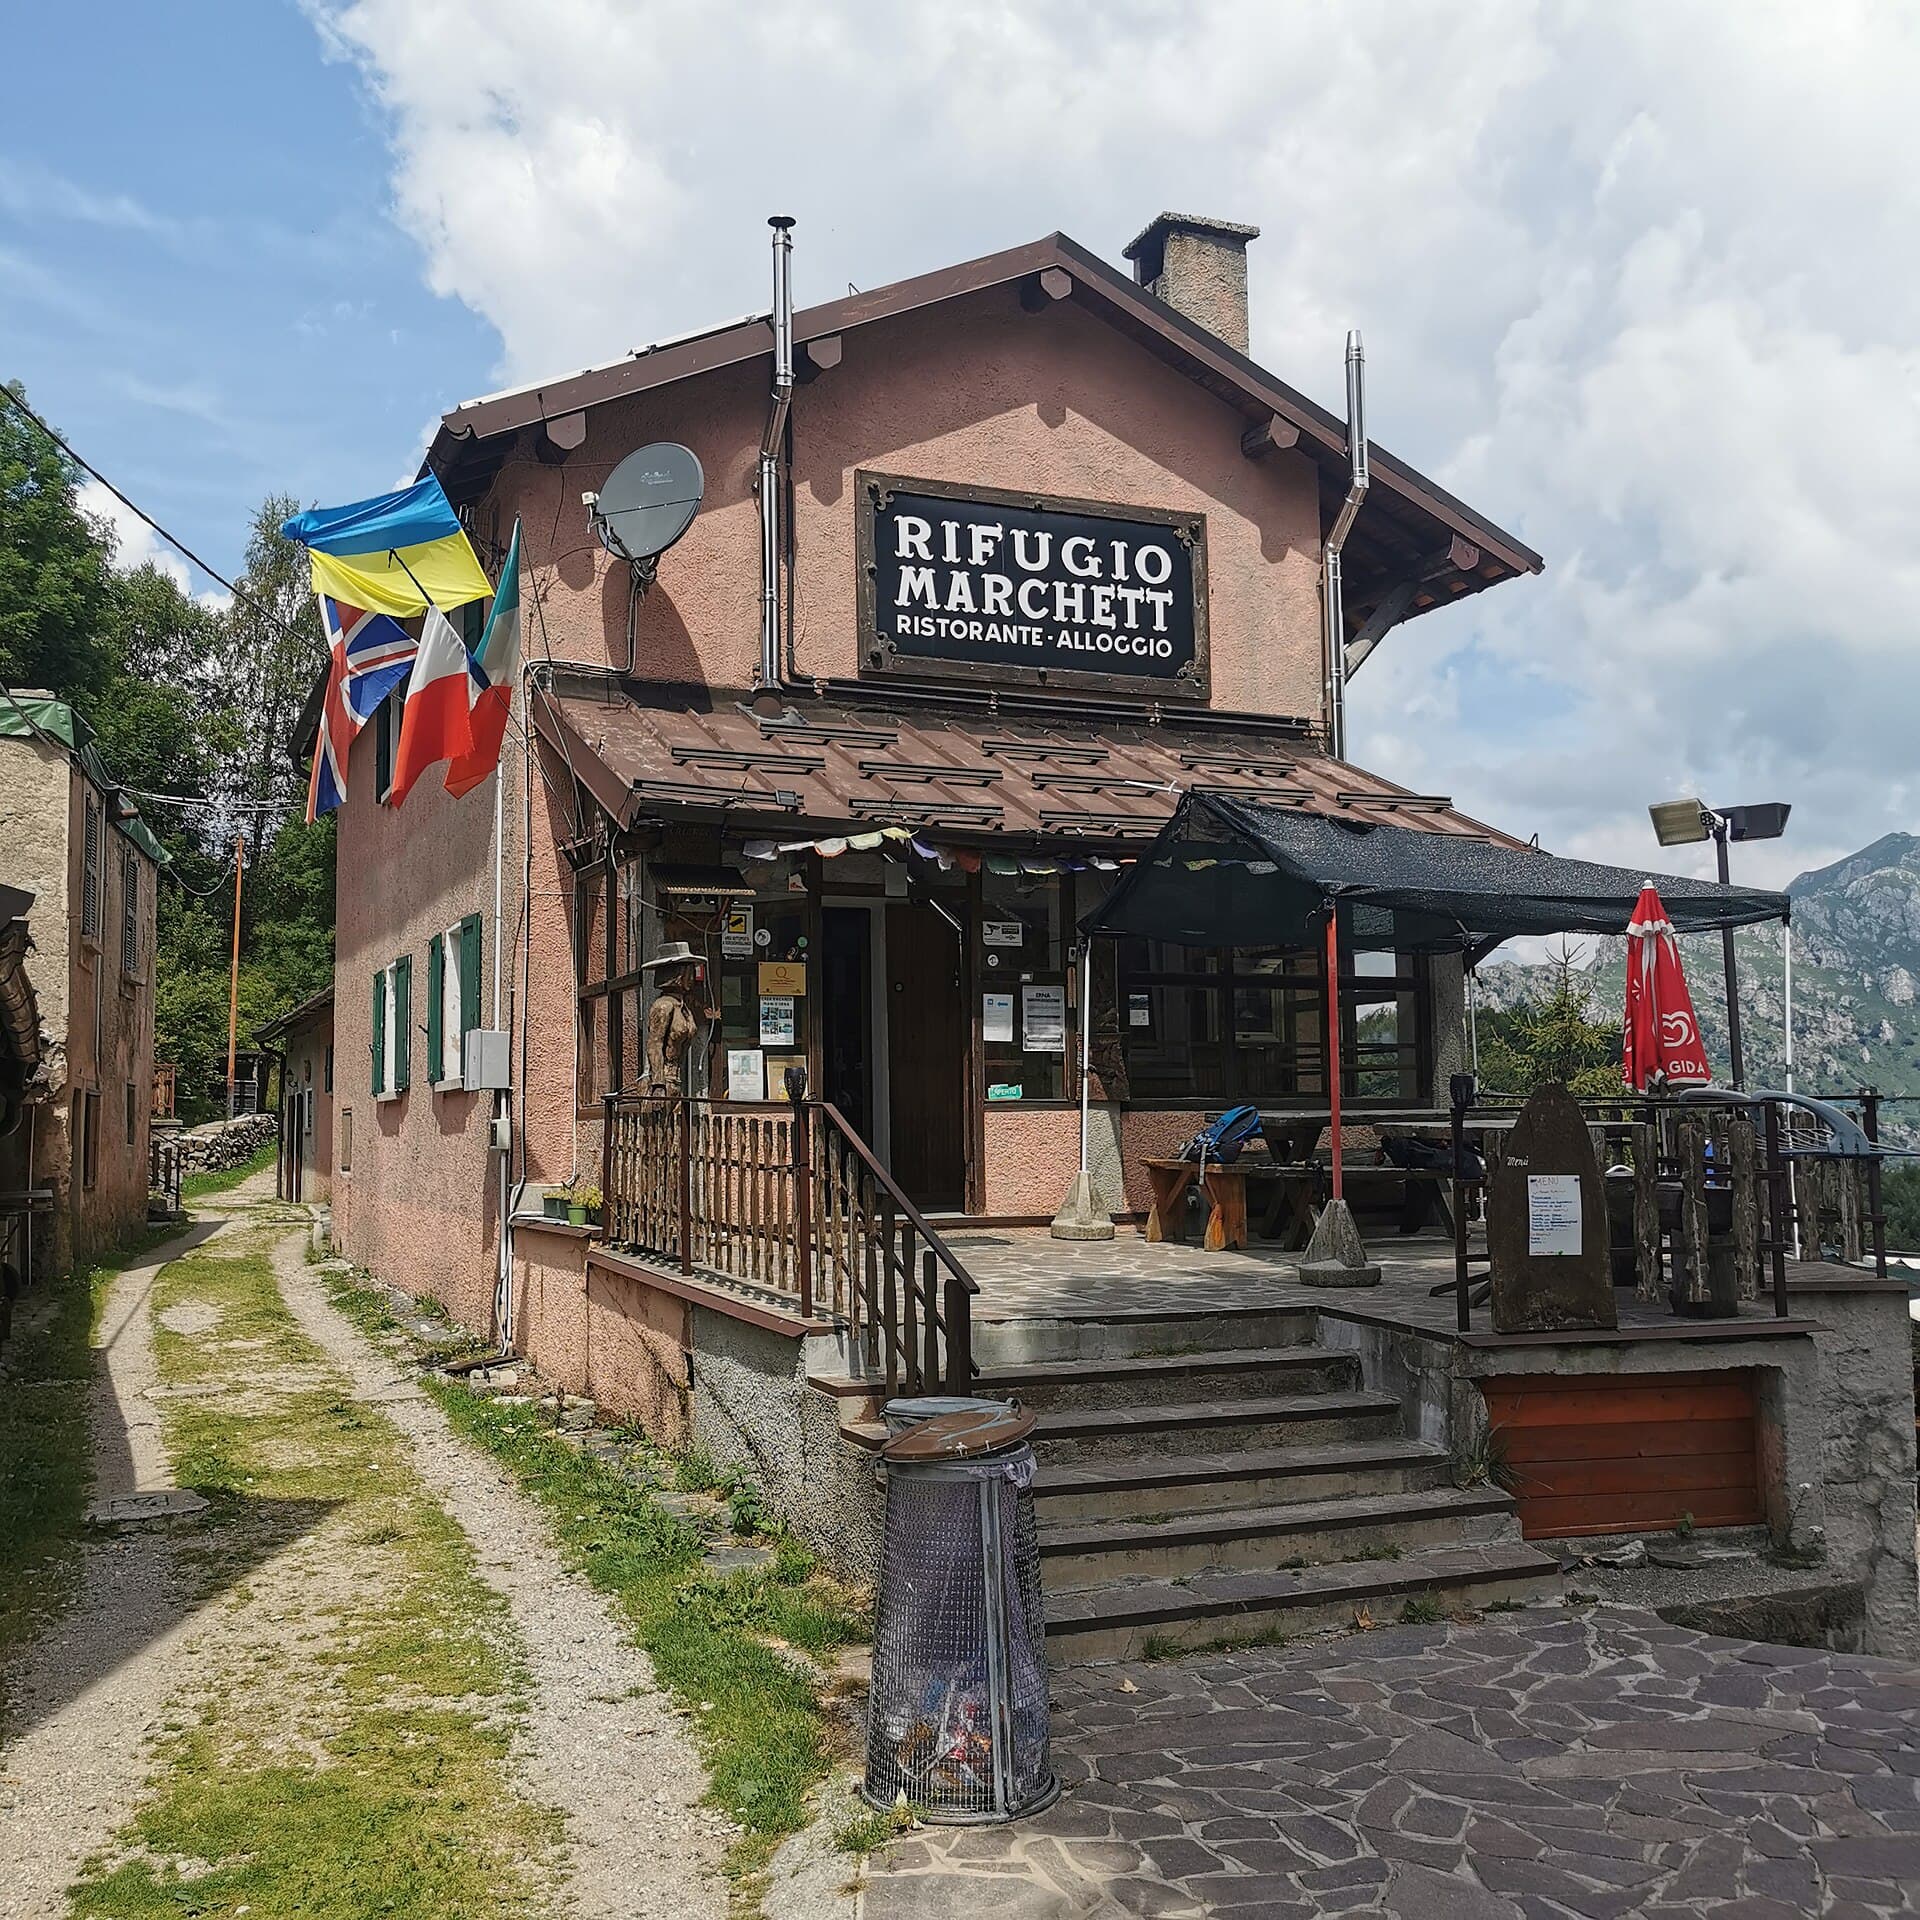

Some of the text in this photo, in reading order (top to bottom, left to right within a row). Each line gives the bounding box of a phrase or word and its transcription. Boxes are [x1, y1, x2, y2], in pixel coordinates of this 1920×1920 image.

[893, 515, 1173, 585] RIFUGIO
[893, 565, 1174, 632] MARCHETT
[896, 614, 1044, 647] RISTORANTE
[1056, 629, 1173, 659] ALLOGGIO
[1667, 1060, 1705, 1076] GIDA
